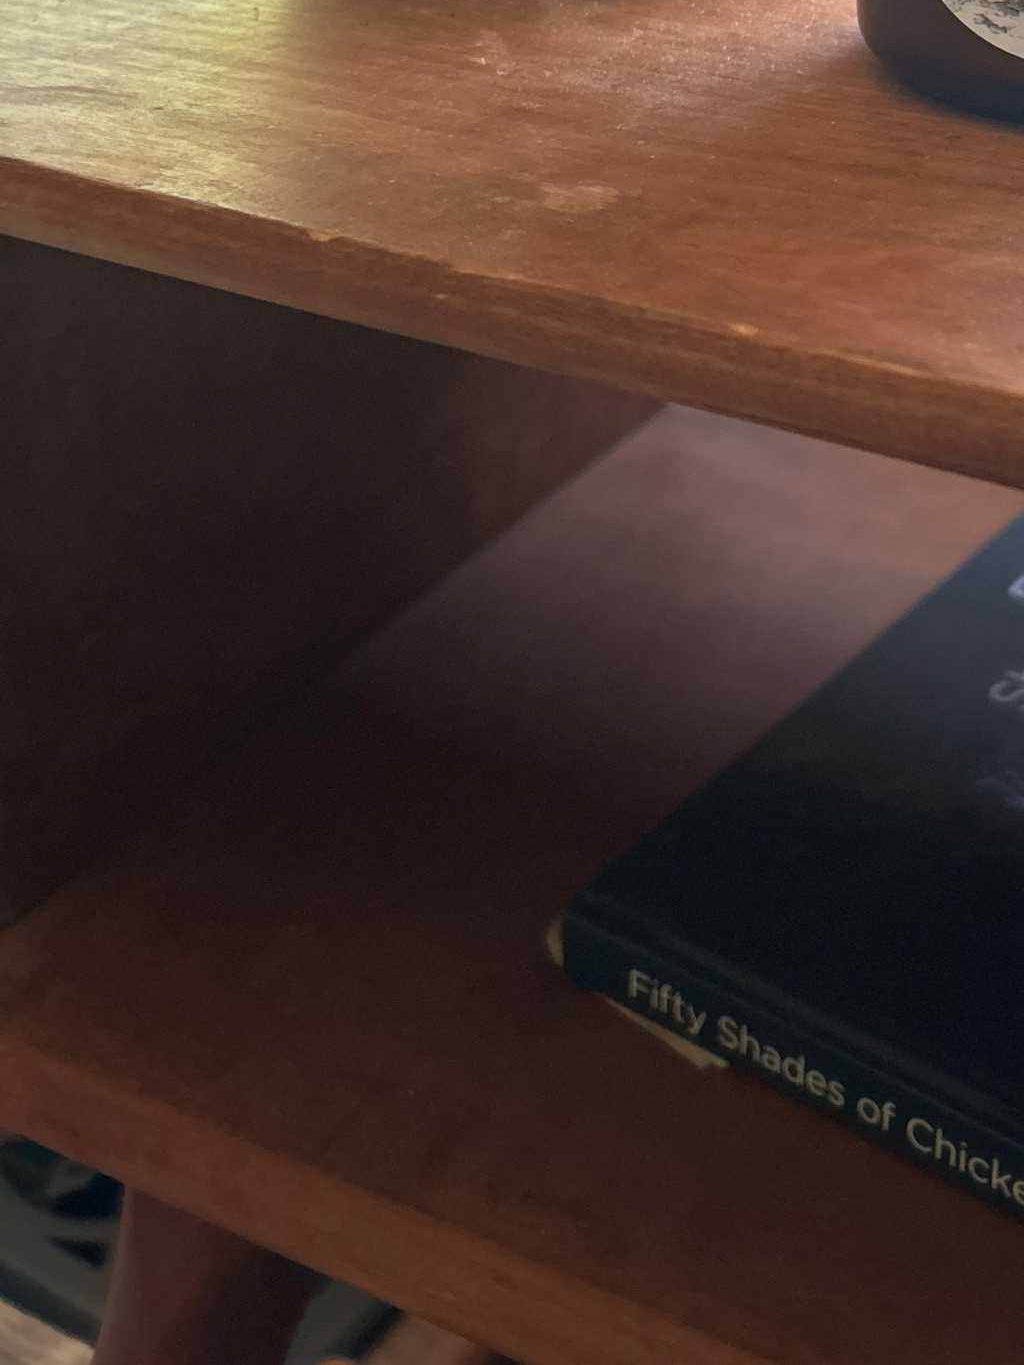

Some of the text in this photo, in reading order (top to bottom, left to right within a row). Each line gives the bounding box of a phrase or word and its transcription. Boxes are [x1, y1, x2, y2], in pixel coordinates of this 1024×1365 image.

[627, 968, 707, 1035] Fifty
[716, 1014, 848, 1108] Shades
[856, 1095, 897, 1131] of
